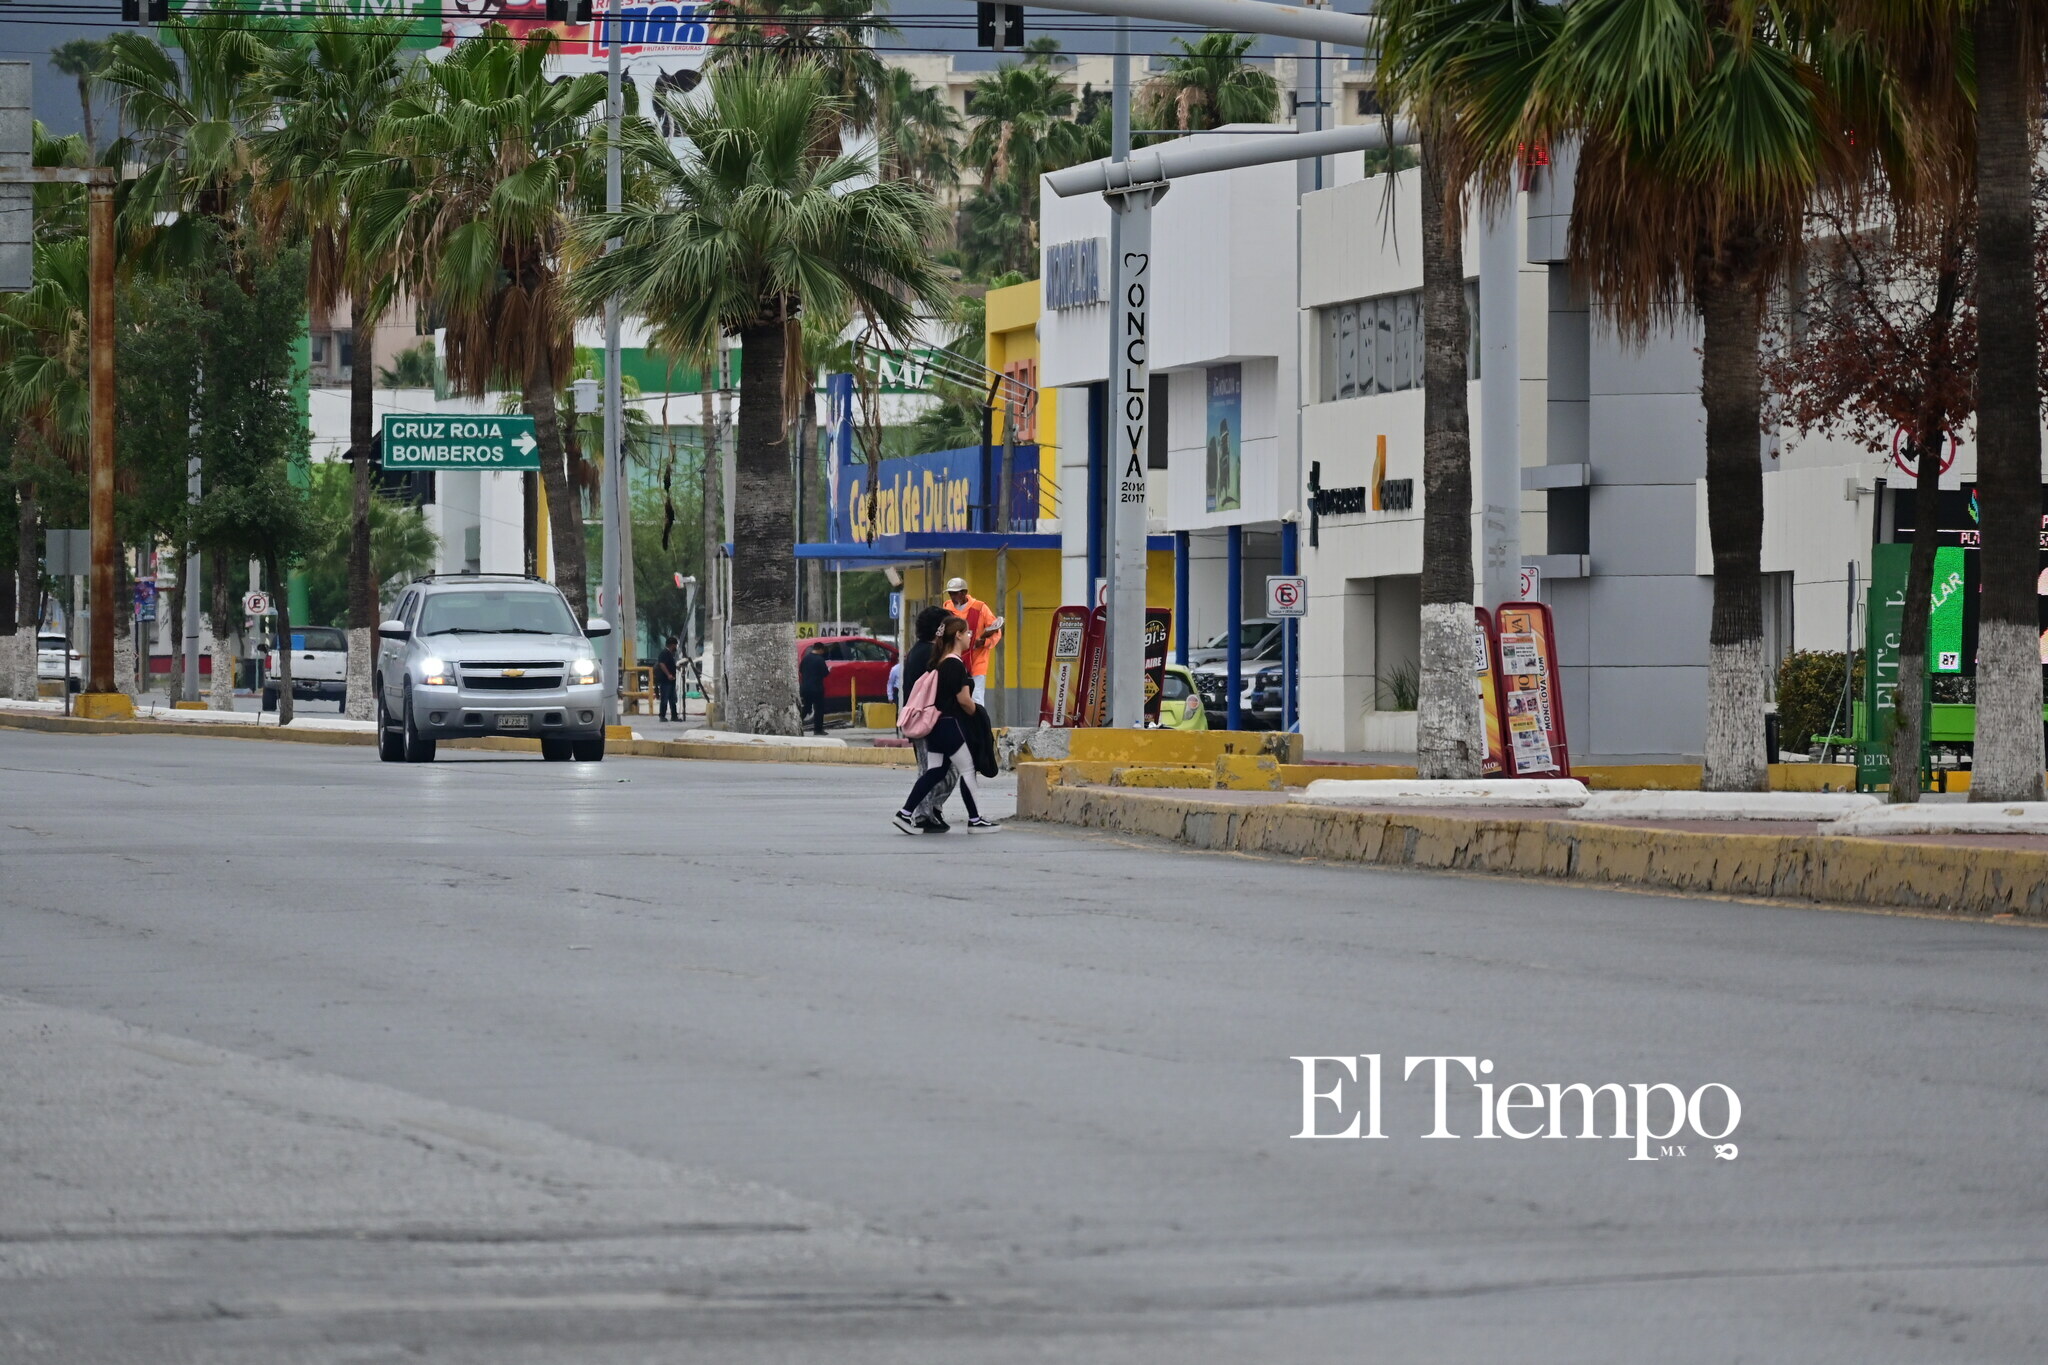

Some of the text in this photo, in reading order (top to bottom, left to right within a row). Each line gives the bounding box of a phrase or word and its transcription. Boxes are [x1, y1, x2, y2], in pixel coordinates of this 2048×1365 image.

[393, 423, 502, 439] CRUZ ROJA
[392, 446, 504, 462] BOMBEROS
[1121, 482, 1145, 492] 2014
[902, 469, 920, 533] de
[1121, 493, 1145, 503] 2017
[1056, 665, 1068, 723] MONCLOVA.COM
[1538, 656, 1551, 730] MONCLOVA.COM
[1864, 754, 1875, 766] El
